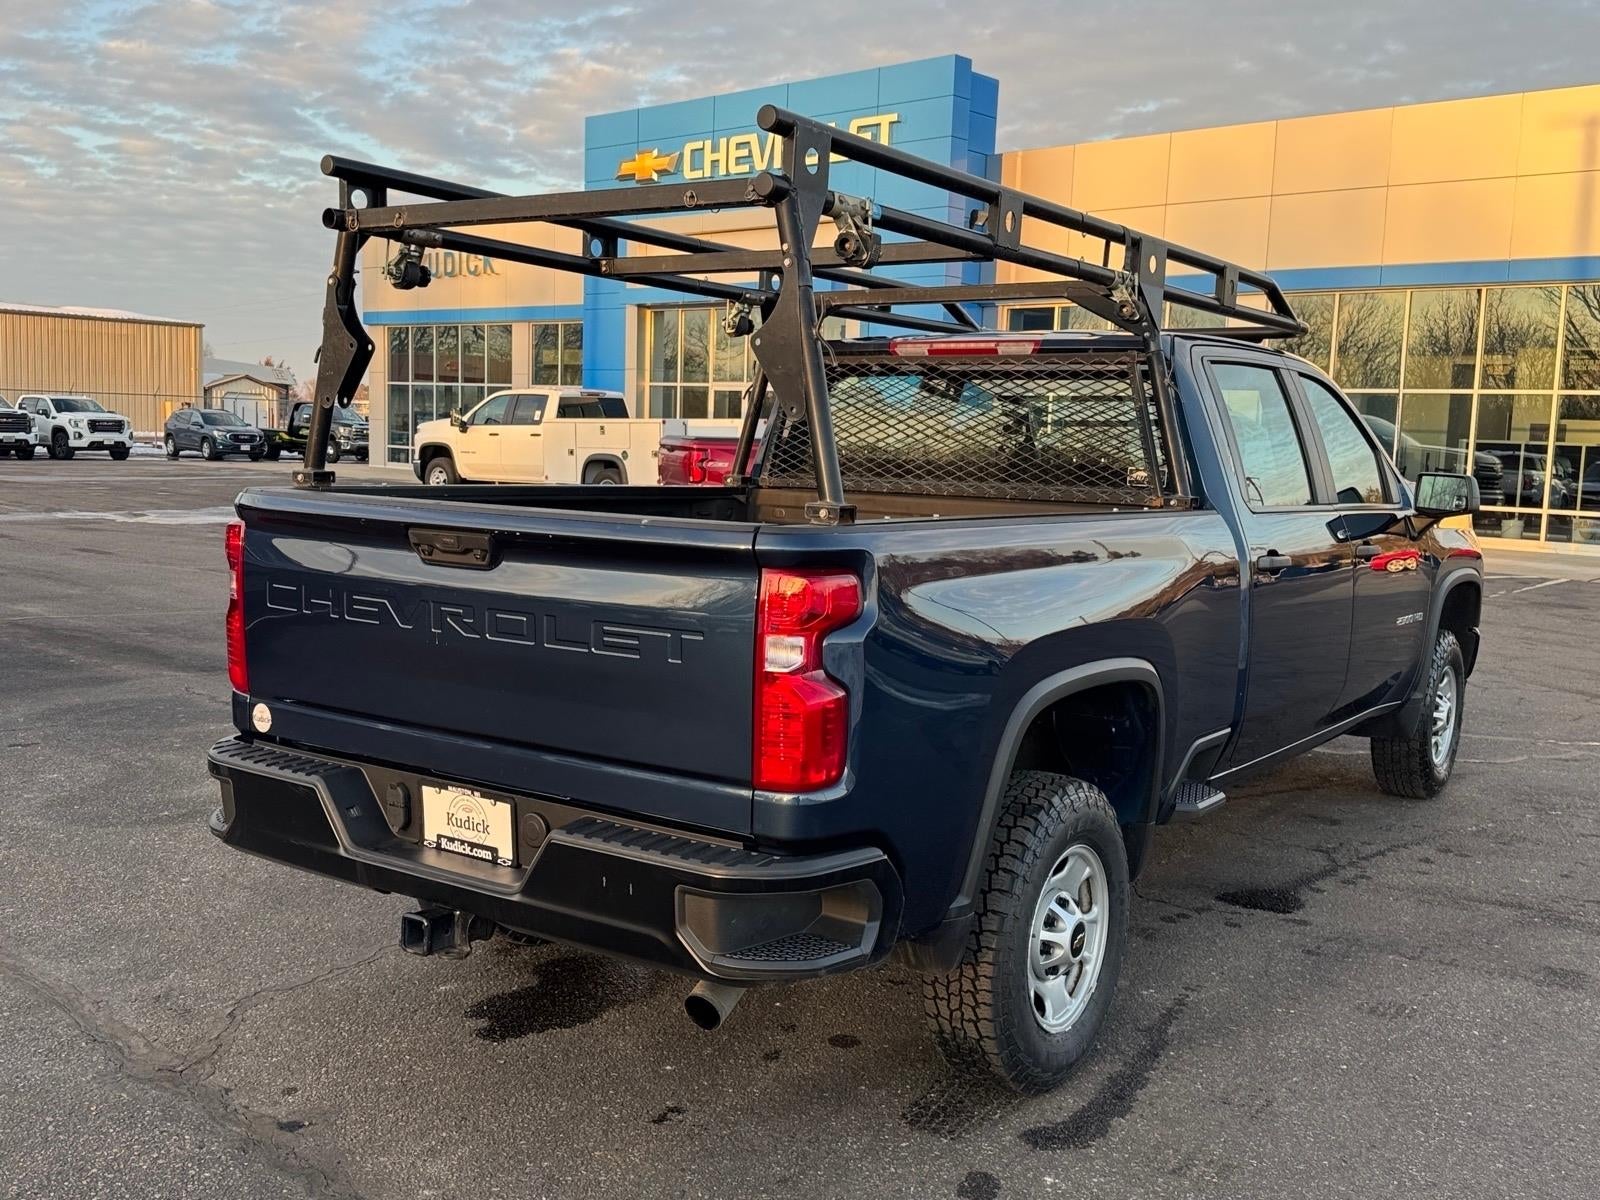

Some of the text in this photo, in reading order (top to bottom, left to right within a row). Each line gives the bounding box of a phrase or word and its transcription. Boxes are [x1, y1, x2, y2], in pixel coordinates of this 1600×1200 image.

[682, 112, 899, 179] CHEVET
[266, 580, 705, 663] CHEVROLET
[446, 811, 490, 836] Kudick
[440, 838, 492, 860] Kudick.com
